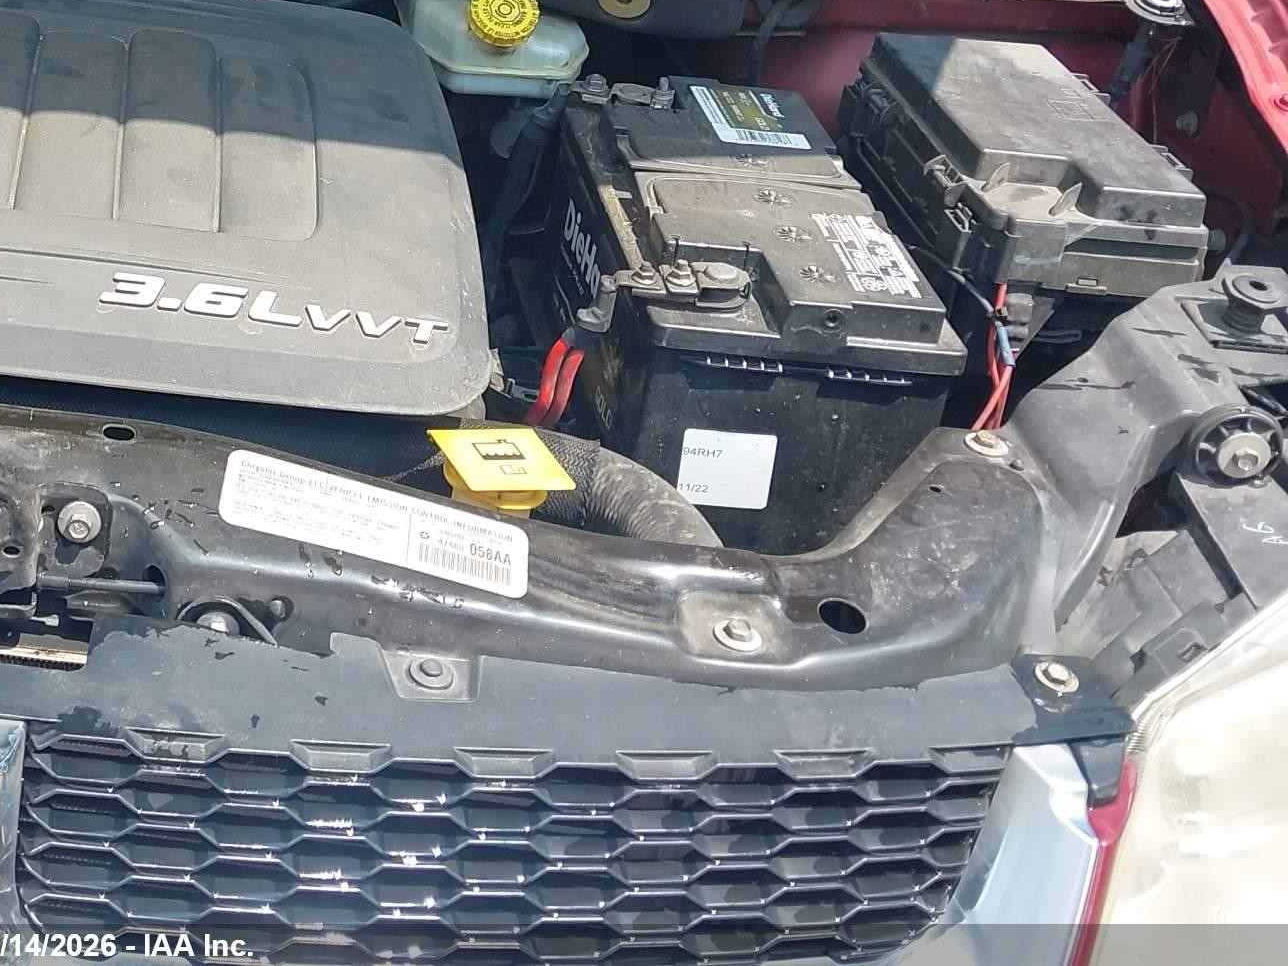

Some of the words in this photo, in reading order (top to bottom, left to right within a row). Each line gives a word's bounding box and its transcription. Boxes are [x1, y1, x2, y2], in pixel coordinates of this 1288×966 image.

[759, 93, 786, 119] DieHard
[564, 198, 601, 299] DieHa
[593, 385, 614, 430] GOLD
[469, 543, 512, 567] 058AA
